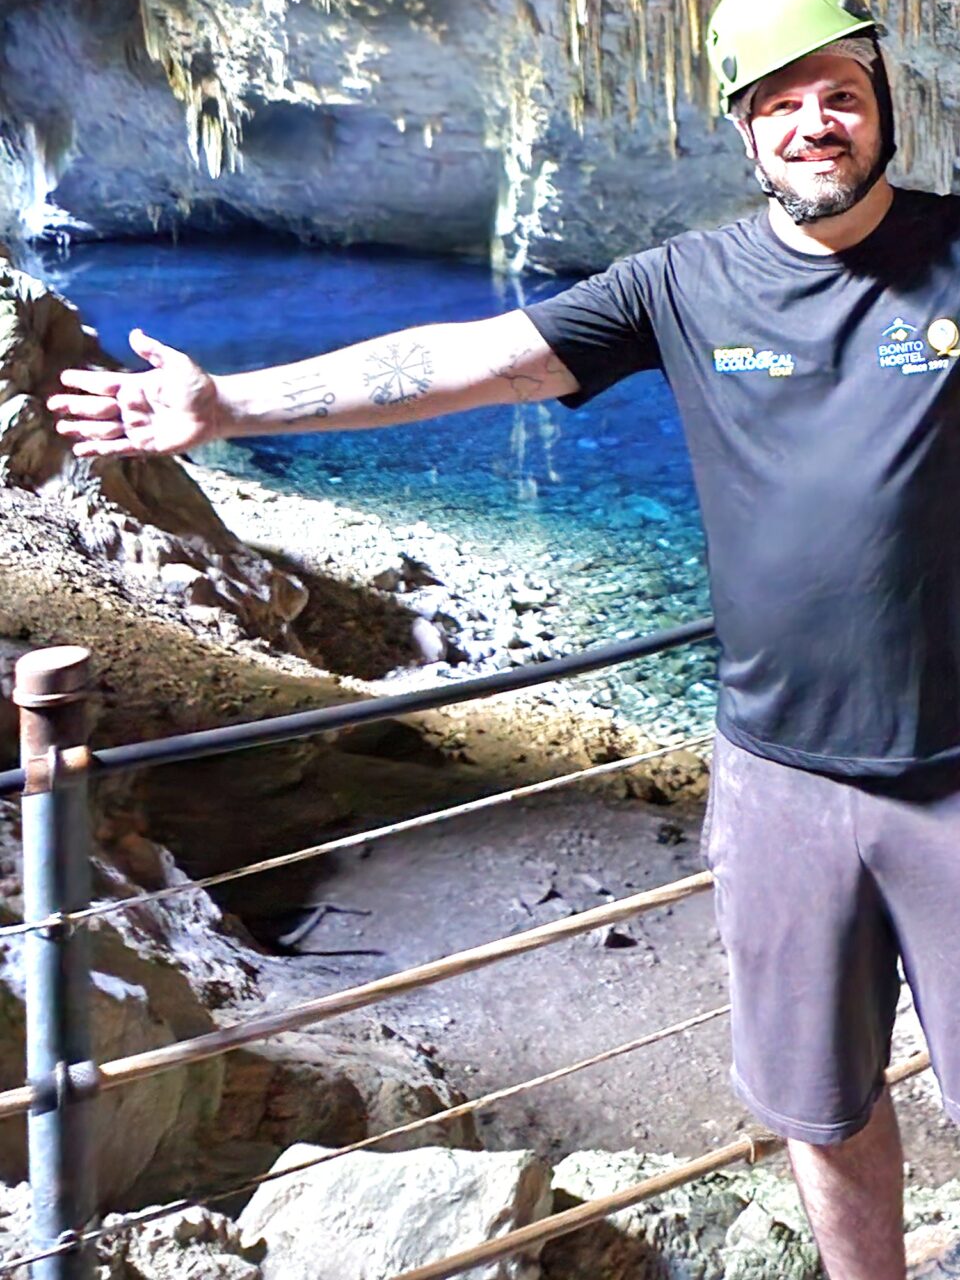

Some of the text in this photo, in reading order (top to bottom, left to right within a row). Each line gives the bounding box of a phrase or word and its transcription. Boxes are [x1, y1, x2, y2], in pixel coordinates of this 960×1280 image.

[878, 340, 924, 356] BONITO
[714, 350, 795, 372] ECOLOGICAL
[879, 352, 926, 367] HOSTEL
